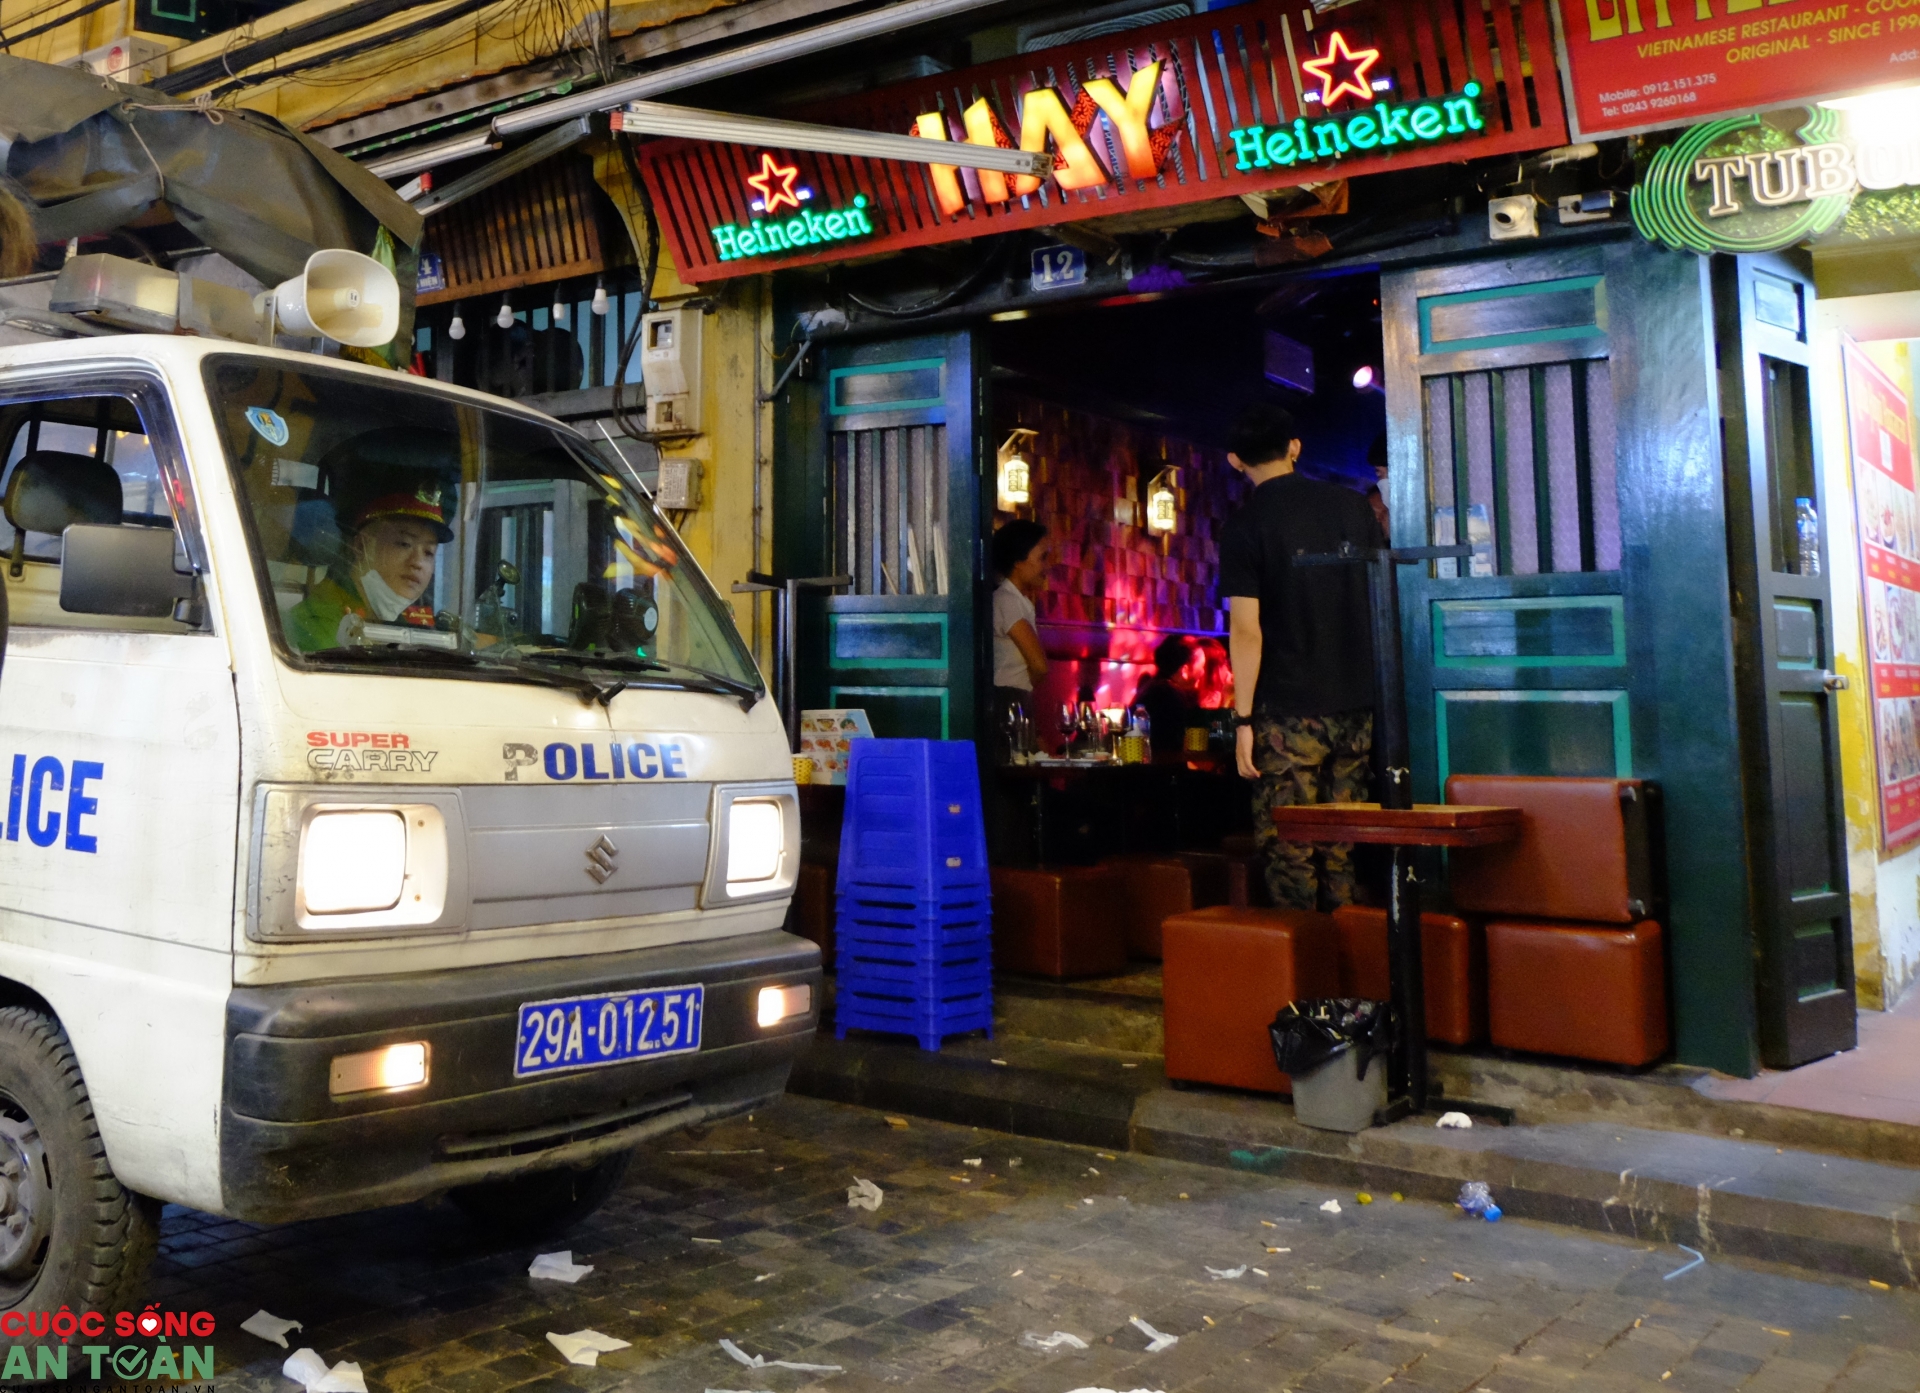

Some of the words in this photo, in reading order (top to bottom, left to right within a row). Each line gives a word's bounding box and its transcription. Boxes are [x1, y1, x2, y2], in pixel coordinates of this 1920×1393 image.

[1637, 26, 1736, 59] VIETNAMESE
[1740, 3, 1849, 40] RESTAURANT
[1725, 34, 1811, 64] ORIGINAL
[1828, 20, 1881, 45] SINCE
[1889, 13, 1920, 33] 199
[1598, 87, 1641, 105] Mobile:
[1642, 72, 1717, 97] 0912.151.375
[1601, 105, 1620, 117] Tel:
[1621, 99, 1648, 114] 0243
[1650, 91, 1697, 108] 9260168
[914, 59, 1167, 215] HAY
[1229, 96, 1483, 171] Heineken
[711, 205, 872, 261] Heineken
[1041, 250, 1075, 283] 12
[306, 731, 410, 749] SUPER
[306, 748, 438, 772] CARRY
[502, 741, 688, 782] POLICE
[0, 752, 104, 854] ICE
[522, 992, 697, 1068] 29A-012.51
